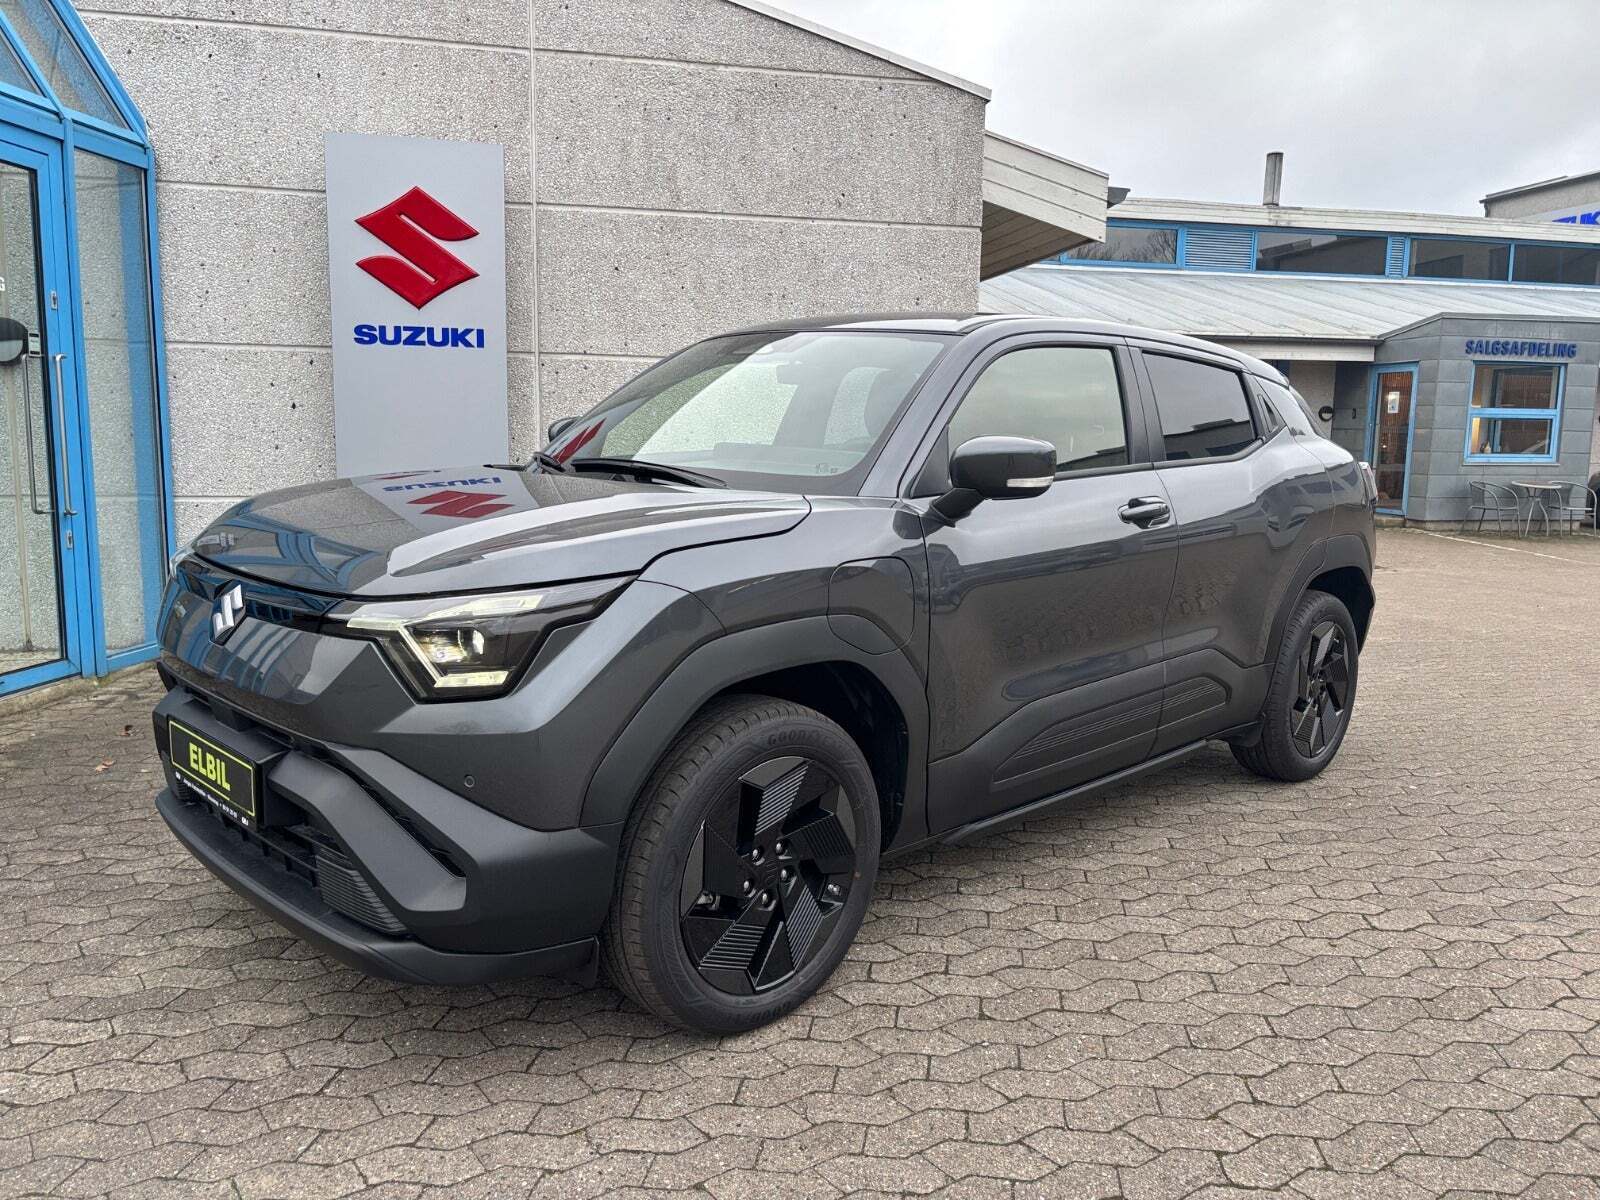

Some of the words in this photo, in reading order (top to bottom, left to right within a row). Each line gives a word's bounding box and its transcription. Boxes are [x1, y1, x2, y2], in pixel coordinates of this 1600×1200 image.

[353, 324, 485, 349] SUZUKI
[1465, 339, 1577, 359] SALGSAFDELING
[189, 741, 231, 791] ELBIL
